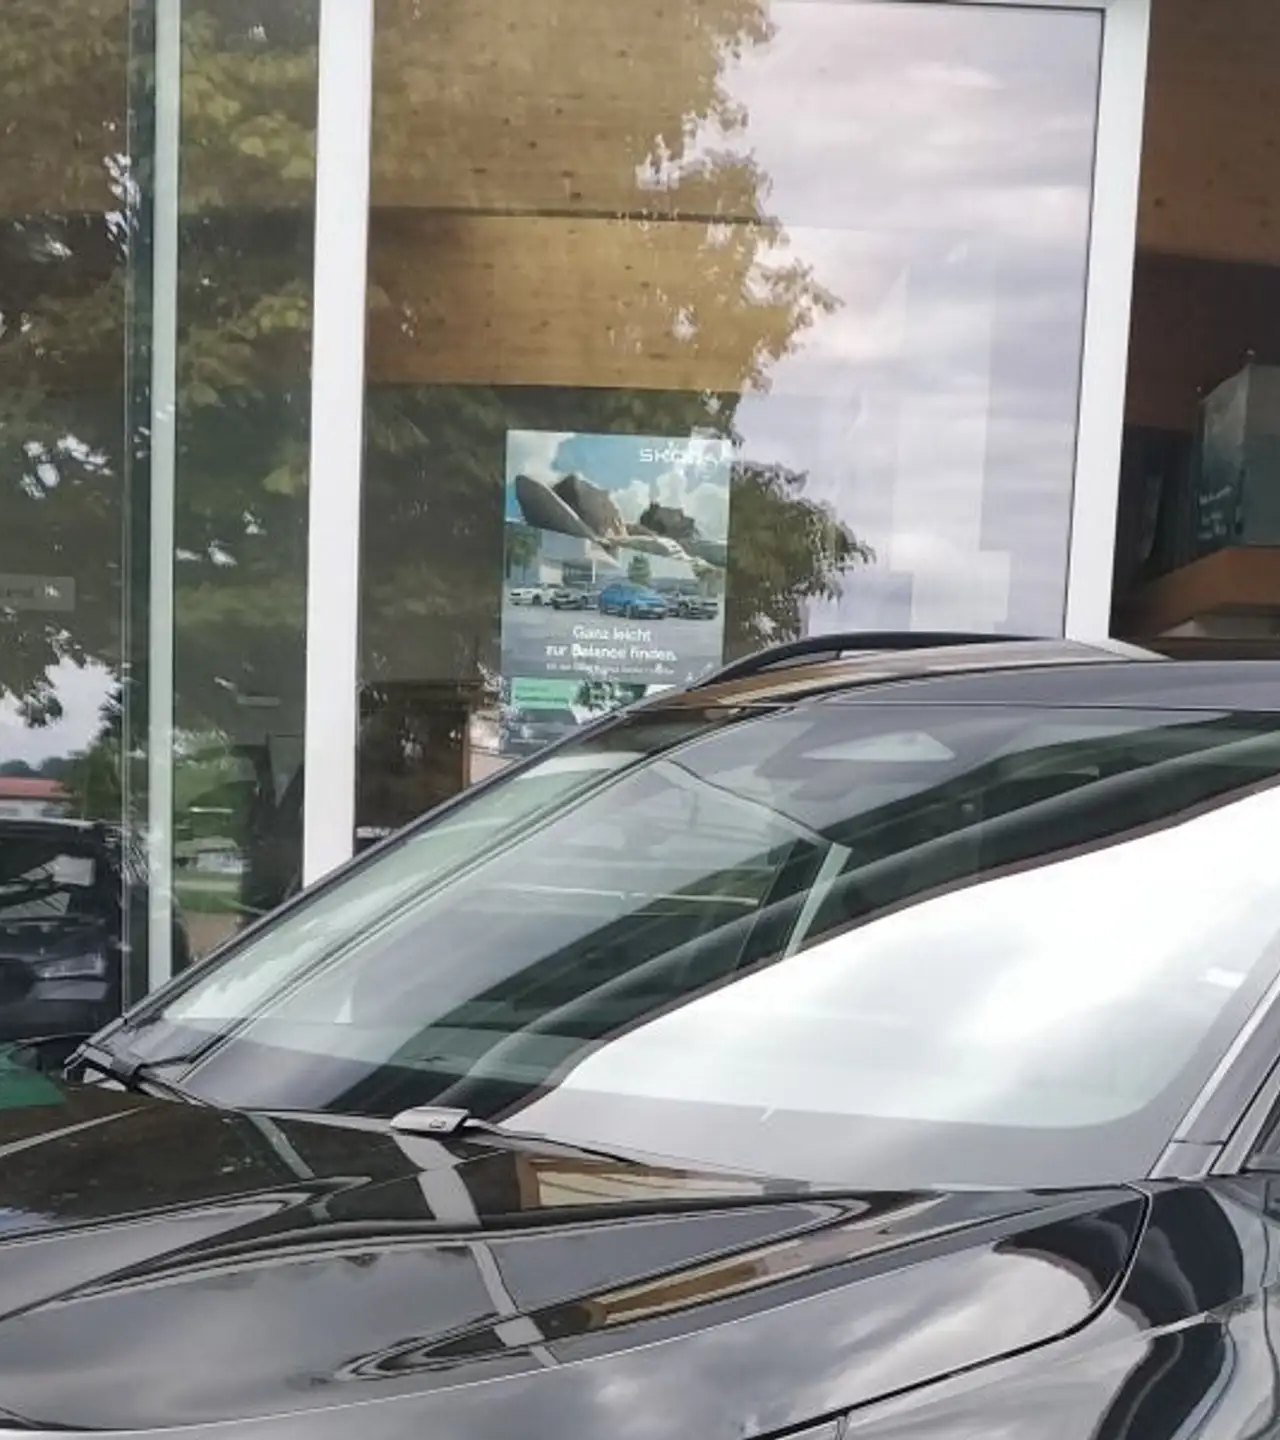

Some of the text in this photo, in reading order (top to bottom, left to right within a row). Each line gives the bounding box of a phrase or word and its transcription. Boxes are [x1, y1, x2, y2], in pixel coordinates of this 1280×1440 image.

[573, 625, 652, 642] Ganz leicht
[545, 645, 568, 657] zur
[572, 643, 627, 659] Balance
